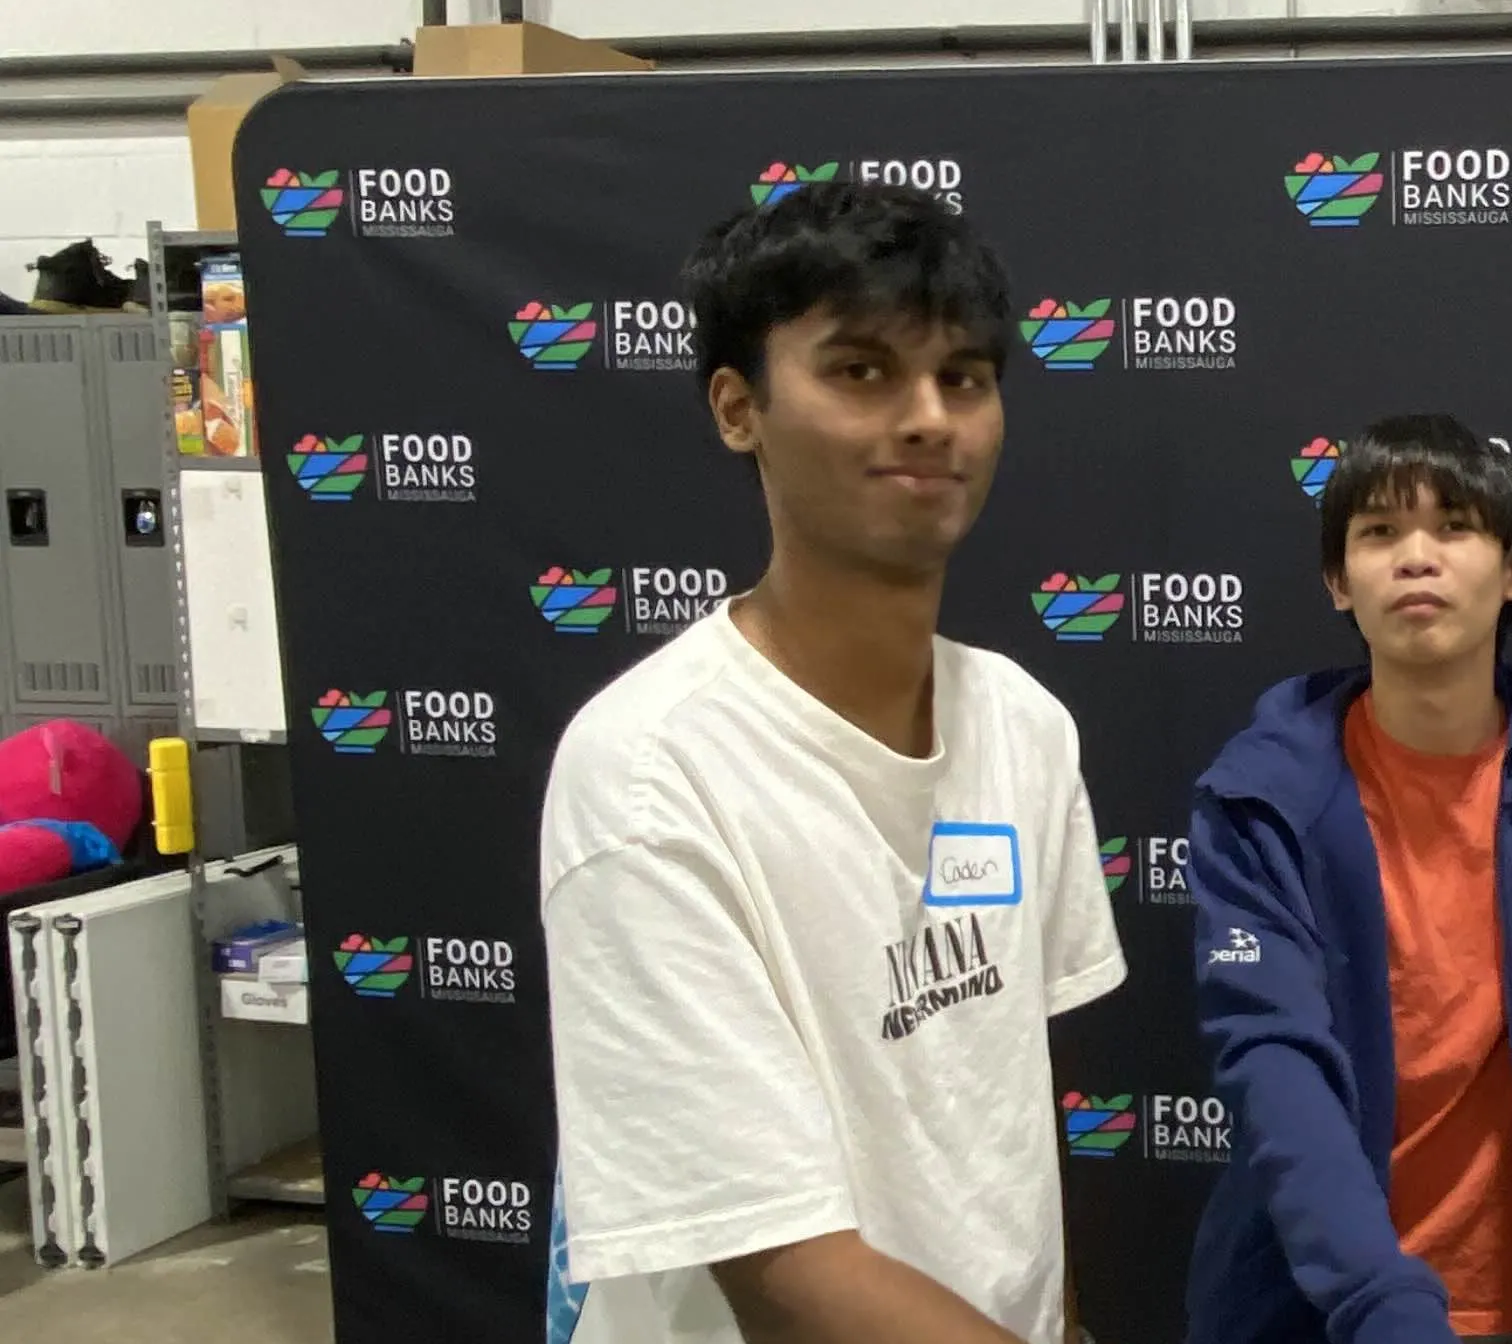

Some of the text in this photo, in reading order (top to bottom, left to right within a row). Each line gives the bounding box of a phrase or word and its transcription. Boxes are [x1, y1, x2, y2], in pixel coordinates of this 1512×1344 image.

[861, 159, 961, 189] FOOD
[1402, 149, 1510, 181] FOOD
[358, 168, 451, 198] FOOD
[1402, 183, 1510, 209] BANKS
[360, 199, 454, 223] BANKS
[1403, 211, 1509, 225] MISSISSAUGA
[1133, 297, 1236, 328] FOOD
[615, 332, 694, 355] BANK
[1134, 329, 1236, 355] BANKS
[1135, 356, 1236, 370] MISSISSAUGA
[382, 434, 473, 462] FOOD
[384, 462, 476, 488] BANKS
[632, 567, 727, 597] FOOD
[1142, 573, 1243, 604] FOOD
[1142, 604, 1244, 629] BANKS
[404, 690, 495, 720] FOOD
[408, 719, 497, 744] BANKS
[1149, 837, 1190, 866] FO
[427, 937, 514, 968] FOOD
[428, 966, 516, 992] BANKS
[1153, 1094, 1234, 1125] FOO
[1154, 1123, 1232, 1149] BANK
[442, 1177, 531, 1209] FOOD
[444, 1205, 532, 1232] BANKS
